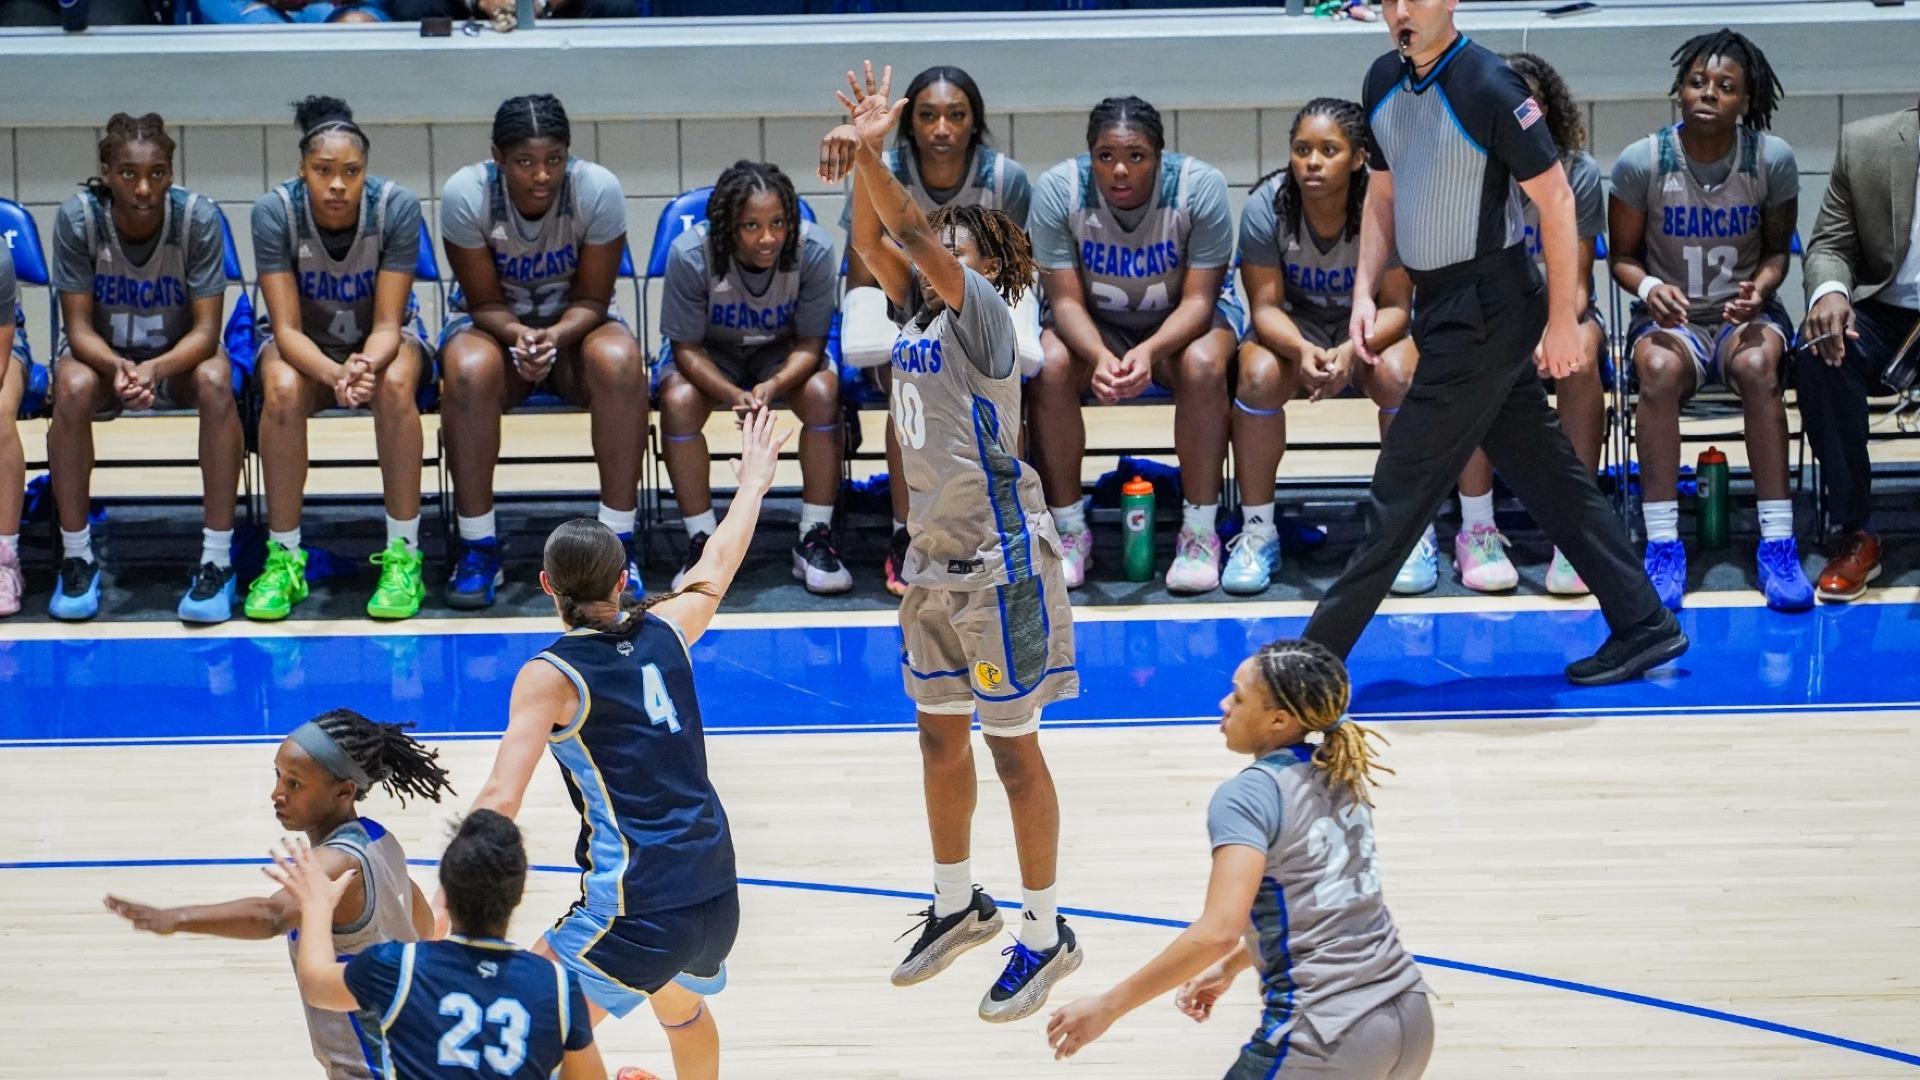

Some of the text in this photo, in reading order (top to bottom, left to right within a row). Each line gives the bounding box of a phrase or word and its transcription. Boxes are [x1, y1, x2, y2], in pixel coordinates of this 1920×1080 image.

[1662, 204, 1760, 237] BEARCATS
[495, 243, 577, 281] EARCATS
[1082, 239, 1178, 278] BEARCATS
[1683, 246, 1739, 298] 12
[93, 273, 186, 309] BEARCATS
[299, 270, 375, 303] EARCAT
[1284, 263, 1357, 292] EARCA
[109, 312, 168, 349] 15
[326, 309, 363, 345] 4
[891, 378, 926, 450] 10
[641, 662, 682, 734] 4
[437, 991, 532, 1077] 23
